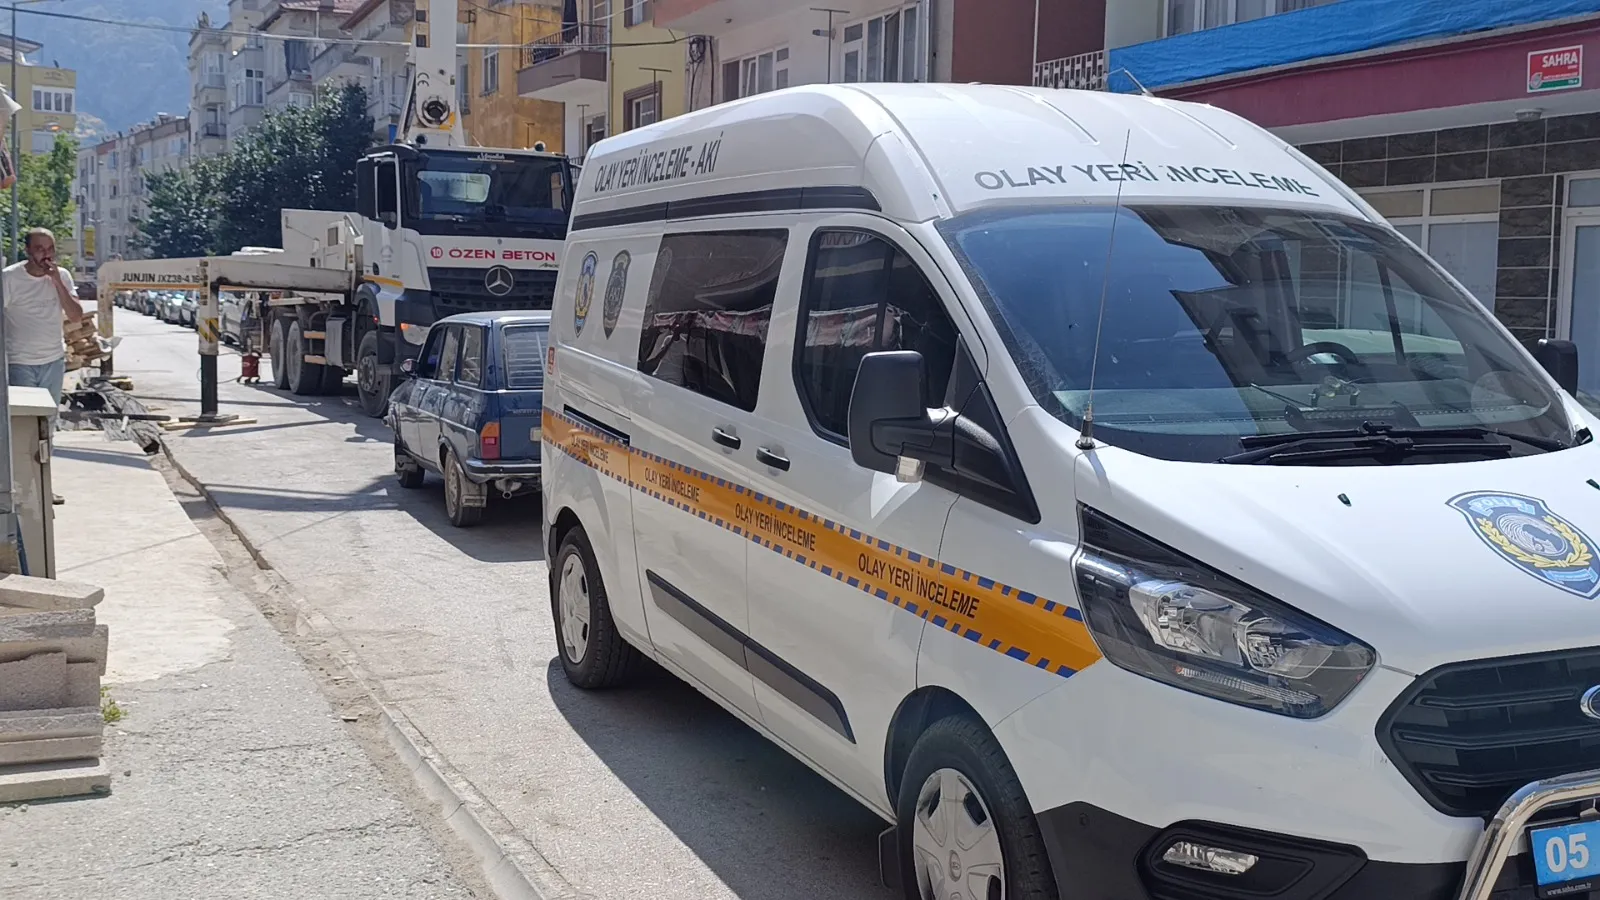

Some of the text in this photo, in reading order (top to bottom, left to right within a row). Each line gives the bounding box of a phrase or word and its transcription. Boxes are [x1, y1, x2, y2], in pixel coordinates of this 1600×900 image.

[1542, 51, 1578, 68] SAHRA
[594, 162, 620, 192] OLAY
[618, 149, 643, 188] YERİ
[638, 146, 693, 184] İNCELEME
[695, 131, 724, 175] AKİ
[974, 165, 1067, 190] OLAY
[1071, 161, 1159, 182] YERİ
[431, 247, 556, 261] 10 ÖZEN BETON
[123, 272, 155, 282] JUNJIN
[644, 467, 658, 485] OLAY
[670, 473, 700, 502] İNCELEME
[735, 502, 816, 552] OLAY YERİ İNCELEME
[858, 552, 980, 619] OLAY YERİ İNCELEME
[1545, 832, 1590, 873] 05
